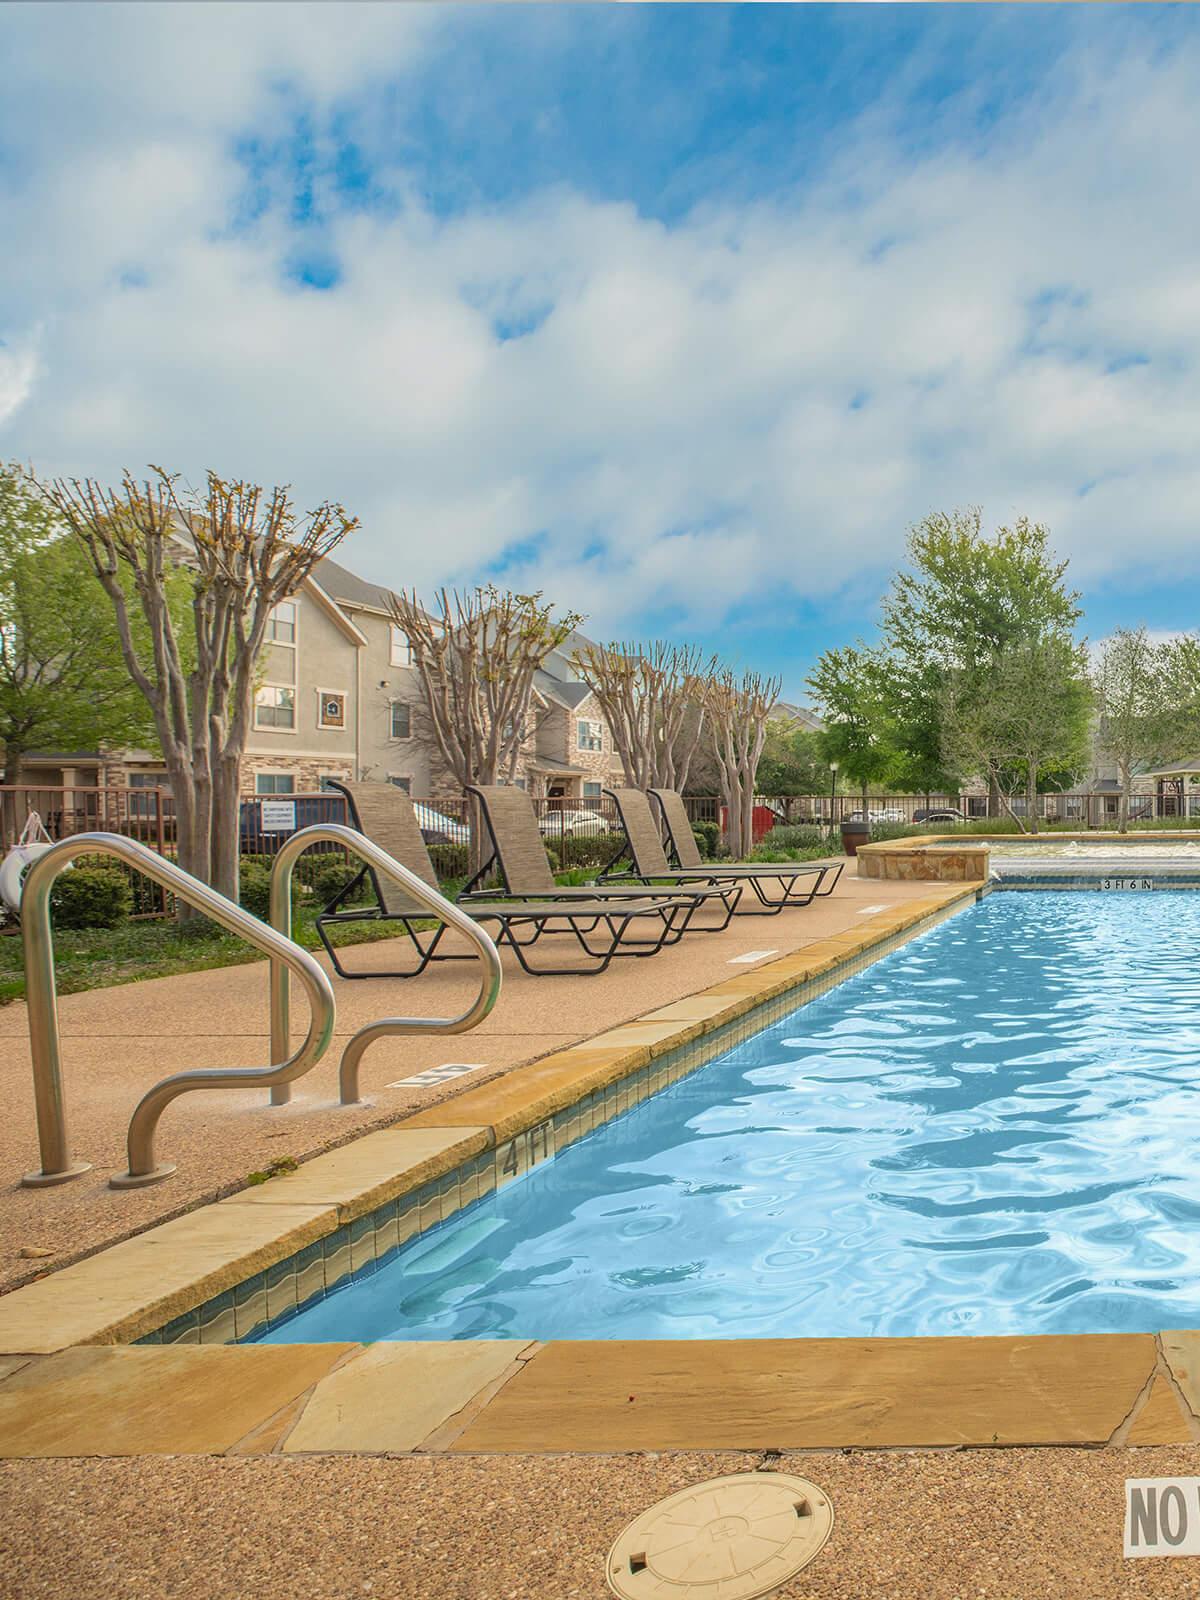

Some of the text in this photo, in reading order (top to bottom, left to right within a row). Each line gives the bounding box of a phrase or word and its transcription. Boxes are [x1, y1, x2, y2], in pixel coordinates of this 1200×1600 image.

[1104, 880, 1151, 889] 3 FT 6 IN
[503, 1121, 550, 1176] 4 FT
[1131, 1487, 1189, 1547] NO
